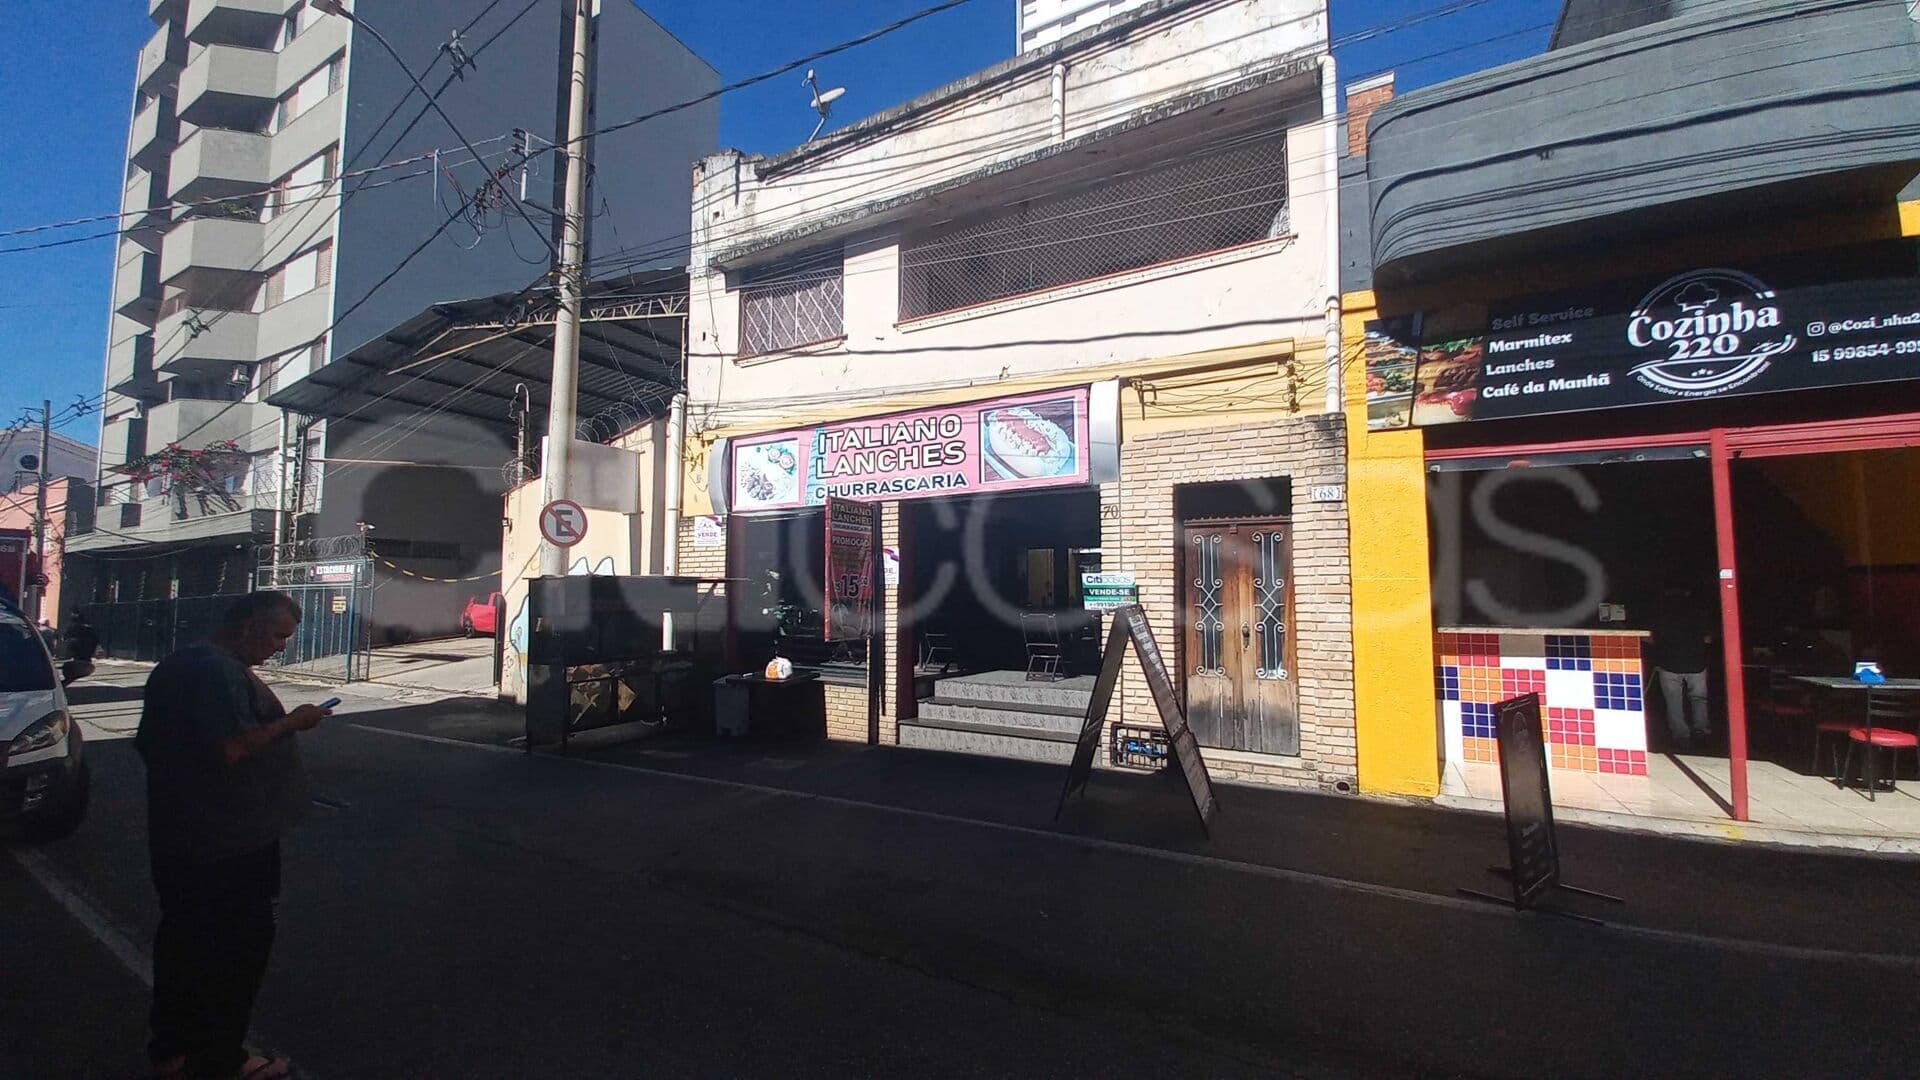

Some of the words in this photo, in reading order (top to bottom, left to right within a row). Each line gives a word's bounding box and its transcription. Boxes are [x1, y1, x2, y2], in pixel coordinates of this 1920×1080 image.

[1491, 312, 1526, 331] Self
[1527, 305, 1595, 325] Service
[1628, 301, 1781, 347] Cozinha
[1488, 332, 1573, 354] Marmitex
[1668, 334, 1739, 361] 220
[1811, 349, 1831, 363] 15
[1485, 358, 1556, 376] Lanches
[1482, 383, 1520, 399] Café
[1522, 380, 1546, 395] da
[1548, 372, 1612, 393] Manhã
[818, 414, 963, 455] ITALIANO
[816, 441, 967, 479] LANCHES
[815, 472, 968, 499] CHURRASCARIA
[1318, 488, 1336, 501] 68
[832, 503, 872, 516] ITALIANO
[1103, 504, 1119, 519] 70
